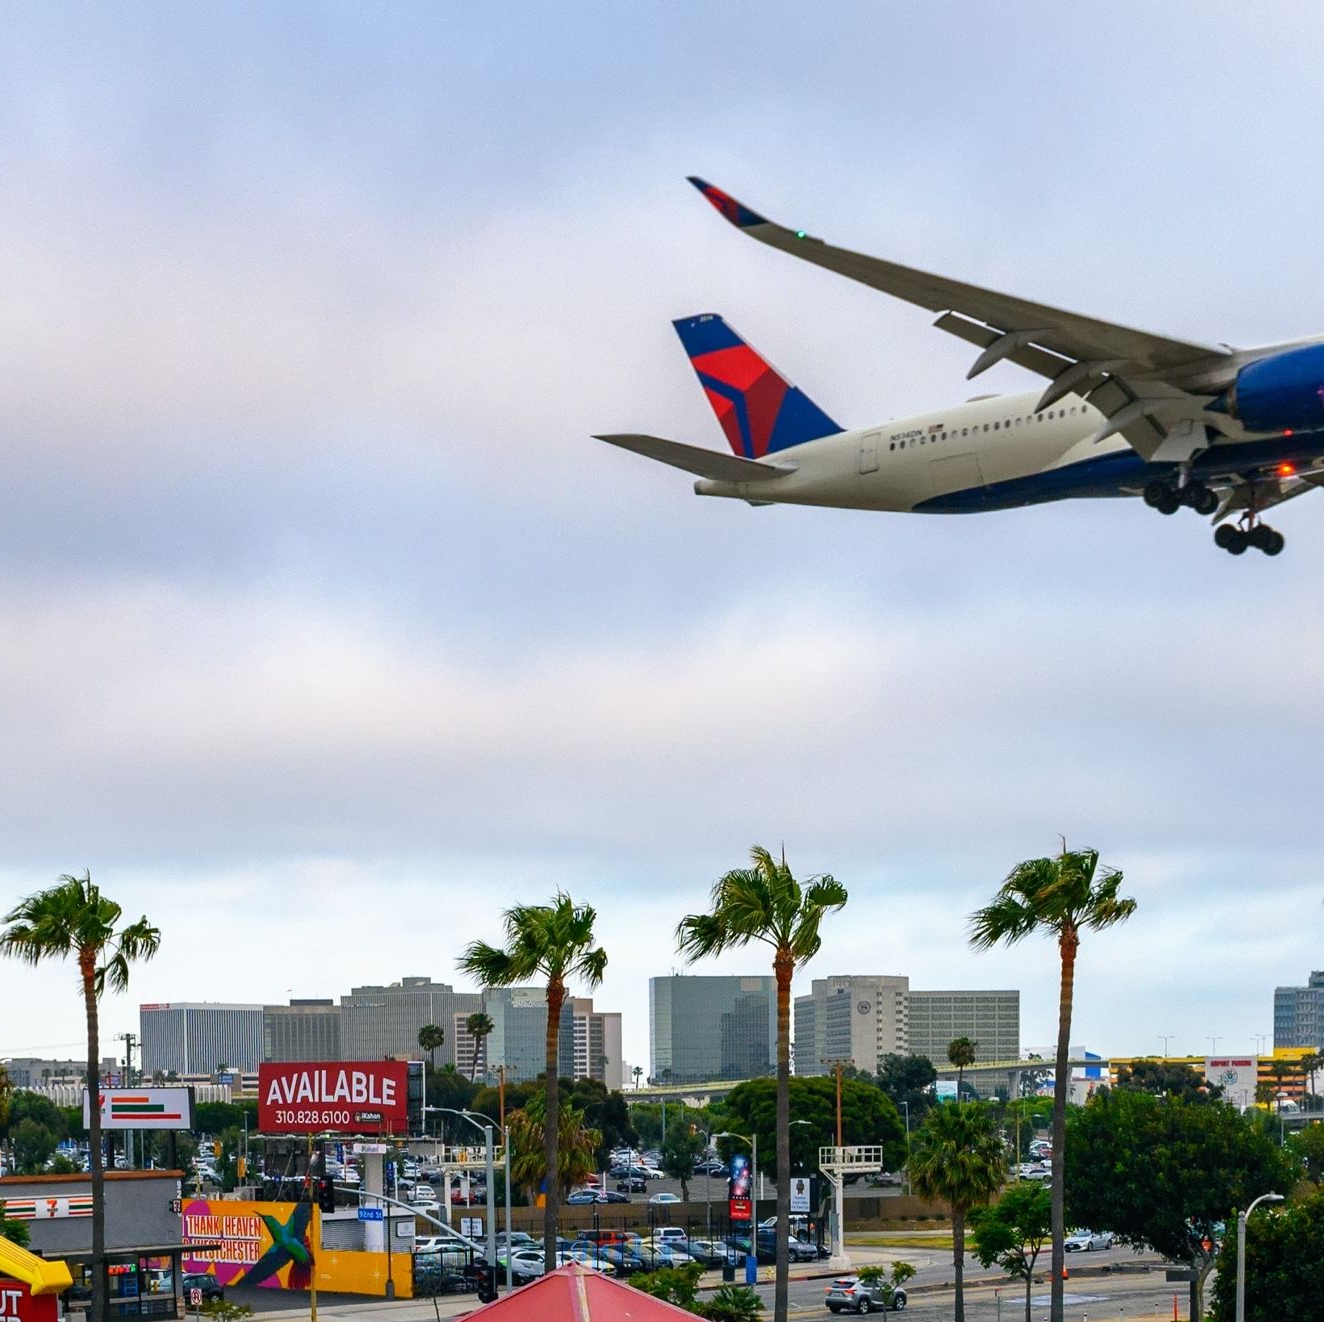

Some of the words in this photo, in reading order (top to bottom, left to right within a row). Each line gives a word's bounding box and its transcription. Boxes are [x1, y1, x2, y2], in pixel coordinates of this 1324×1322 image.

[266, 1069, 397, 1106] AVAILABLE
[275, 1110, 351, 1124] 310.828.6100
[358, 1209, 374, 1219] 92nd
[375, 1210, 382, 1219] St
[187, 1215, 220, 1237] THANK
[223, 1215, 262, 1238] HEAVEN
[194, 1239, 261, 1262] WESTCHESTER
